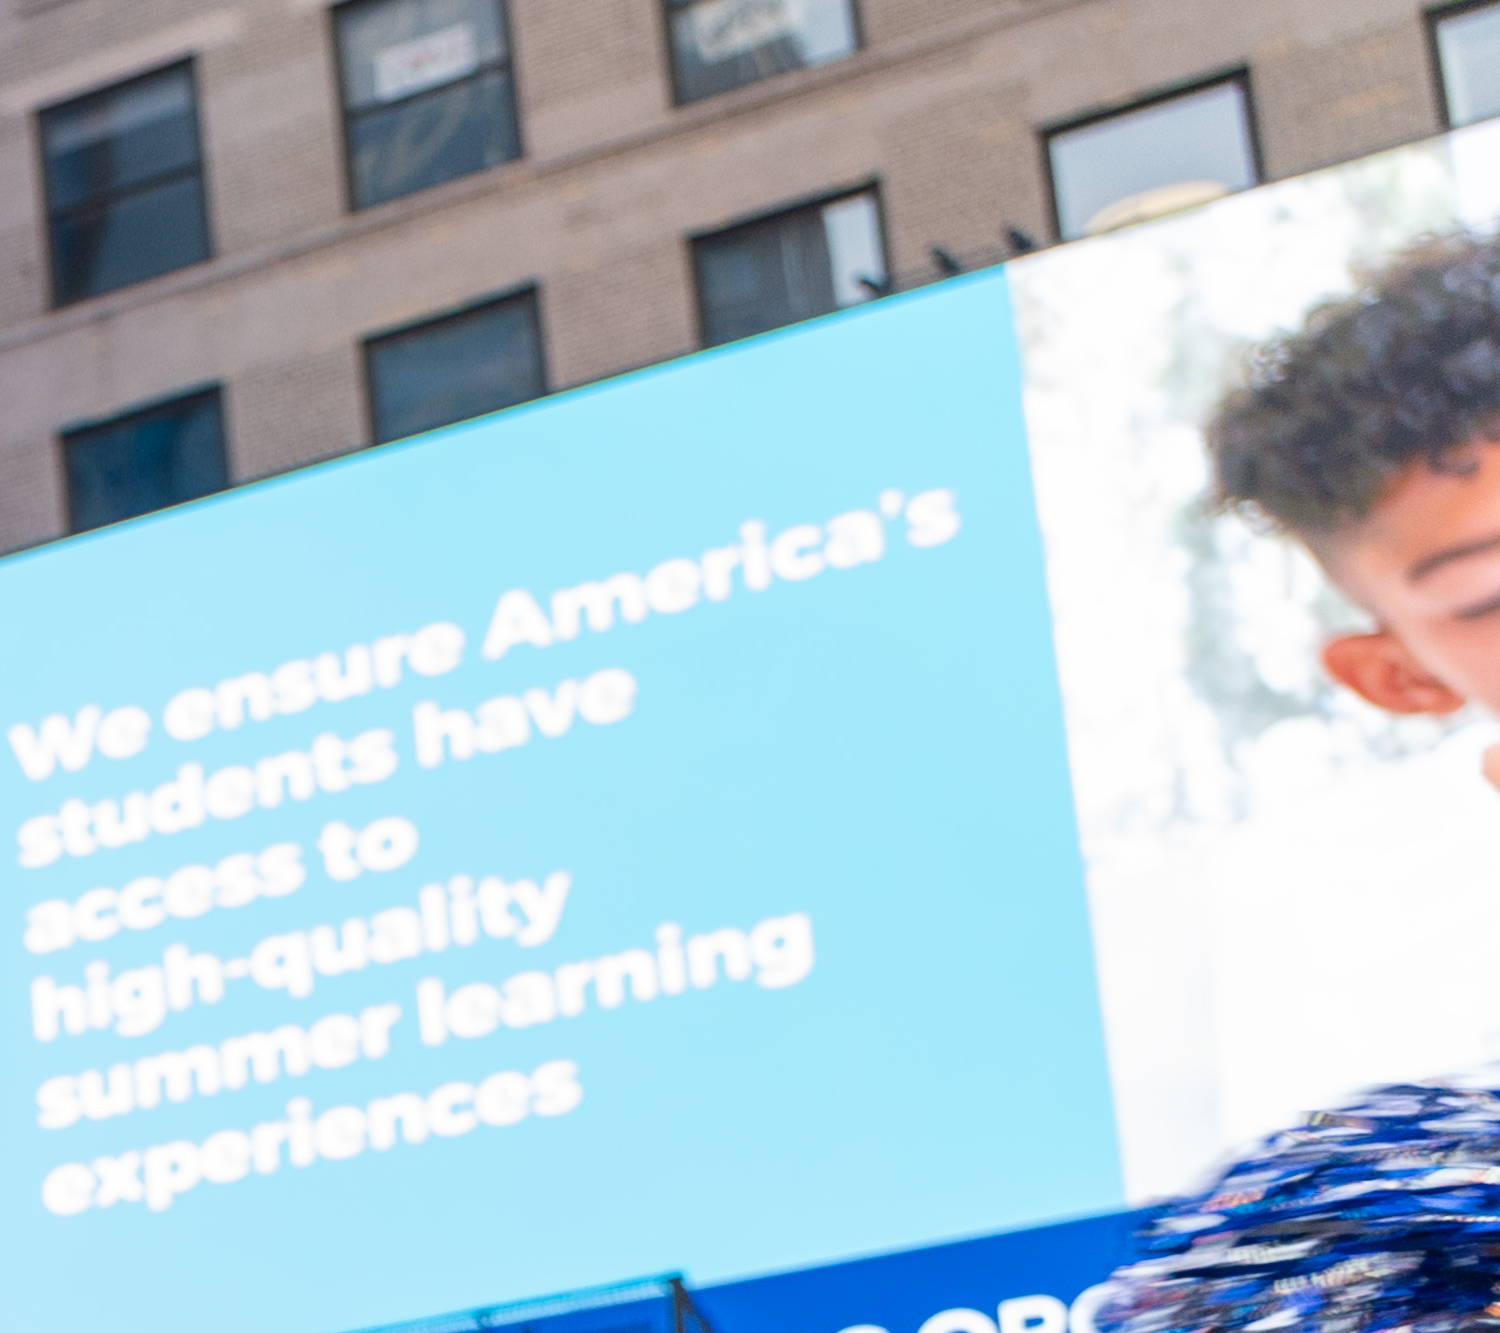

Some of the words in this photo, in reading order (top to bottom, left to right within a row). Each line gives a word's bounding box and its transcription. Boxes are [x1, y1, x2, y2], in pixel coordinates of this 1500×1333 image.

[6, 704, 151, 781] We
[163, 619, 466, 741] ensure
[480, 487, 963, 662] America's
[15, 725, 398, 868] students
[413, 668, 639, 769] have
[23, 839, 306, 954] access
[318, 816, 418, 877] to
[30, 869, 573, 1043] high-quality
[35, 1000, 400, 1130] summer
[417, 912, 815, 1050] learning
[40, 1058, 582, 1216] experiences
